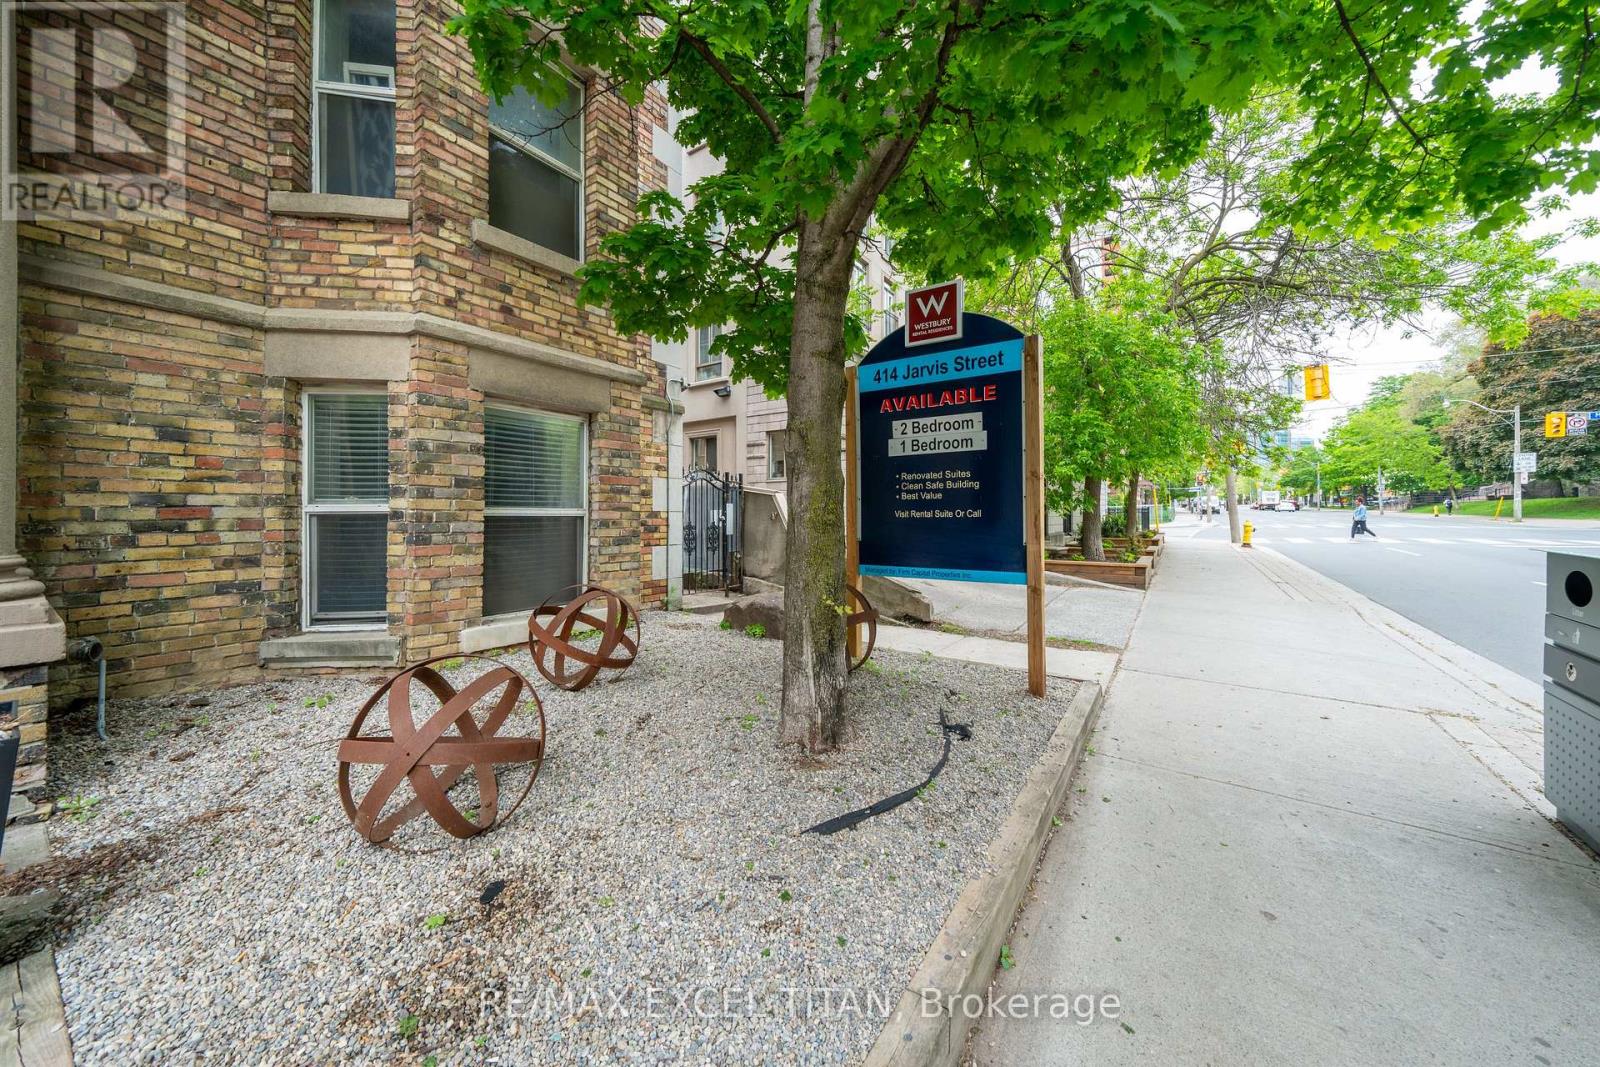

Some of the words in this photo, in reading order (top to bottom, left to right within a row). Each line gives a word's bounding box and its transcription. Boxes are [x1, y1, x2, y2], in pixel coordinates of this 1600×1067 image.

[916, 291, 949, 318] W
[914, 318, 951, 330] WESTBURY
[873, 369, 898, 384] 414
[902, 360, 949, 380] Jarvis
[954, 350, 1004, 372] Street
[880, 384, 996, 413] AVAILABLE
[900, 422, 908, 435] 2
[911, 418, 974, 434] Bedroom
[900, 441, 906, 453] 1
[911, 437, 973, 452] Bedroom
[901, 472, 942, 480] Renovated
[945, 470, 971, 478] Suites
[901, 482, 924, 490] Clean
[926, 481, 944, 490] Safe
[946, 480, 980, 490] Building
[901, 492, 918, 500] Best
[920, 492, 942, 500] Value
[910, 510, 932, 518] Rental
[934, 510, 953, 518] Suite
[954, 510, 964, 518] Or
[966, 509, 982, 518] Call
